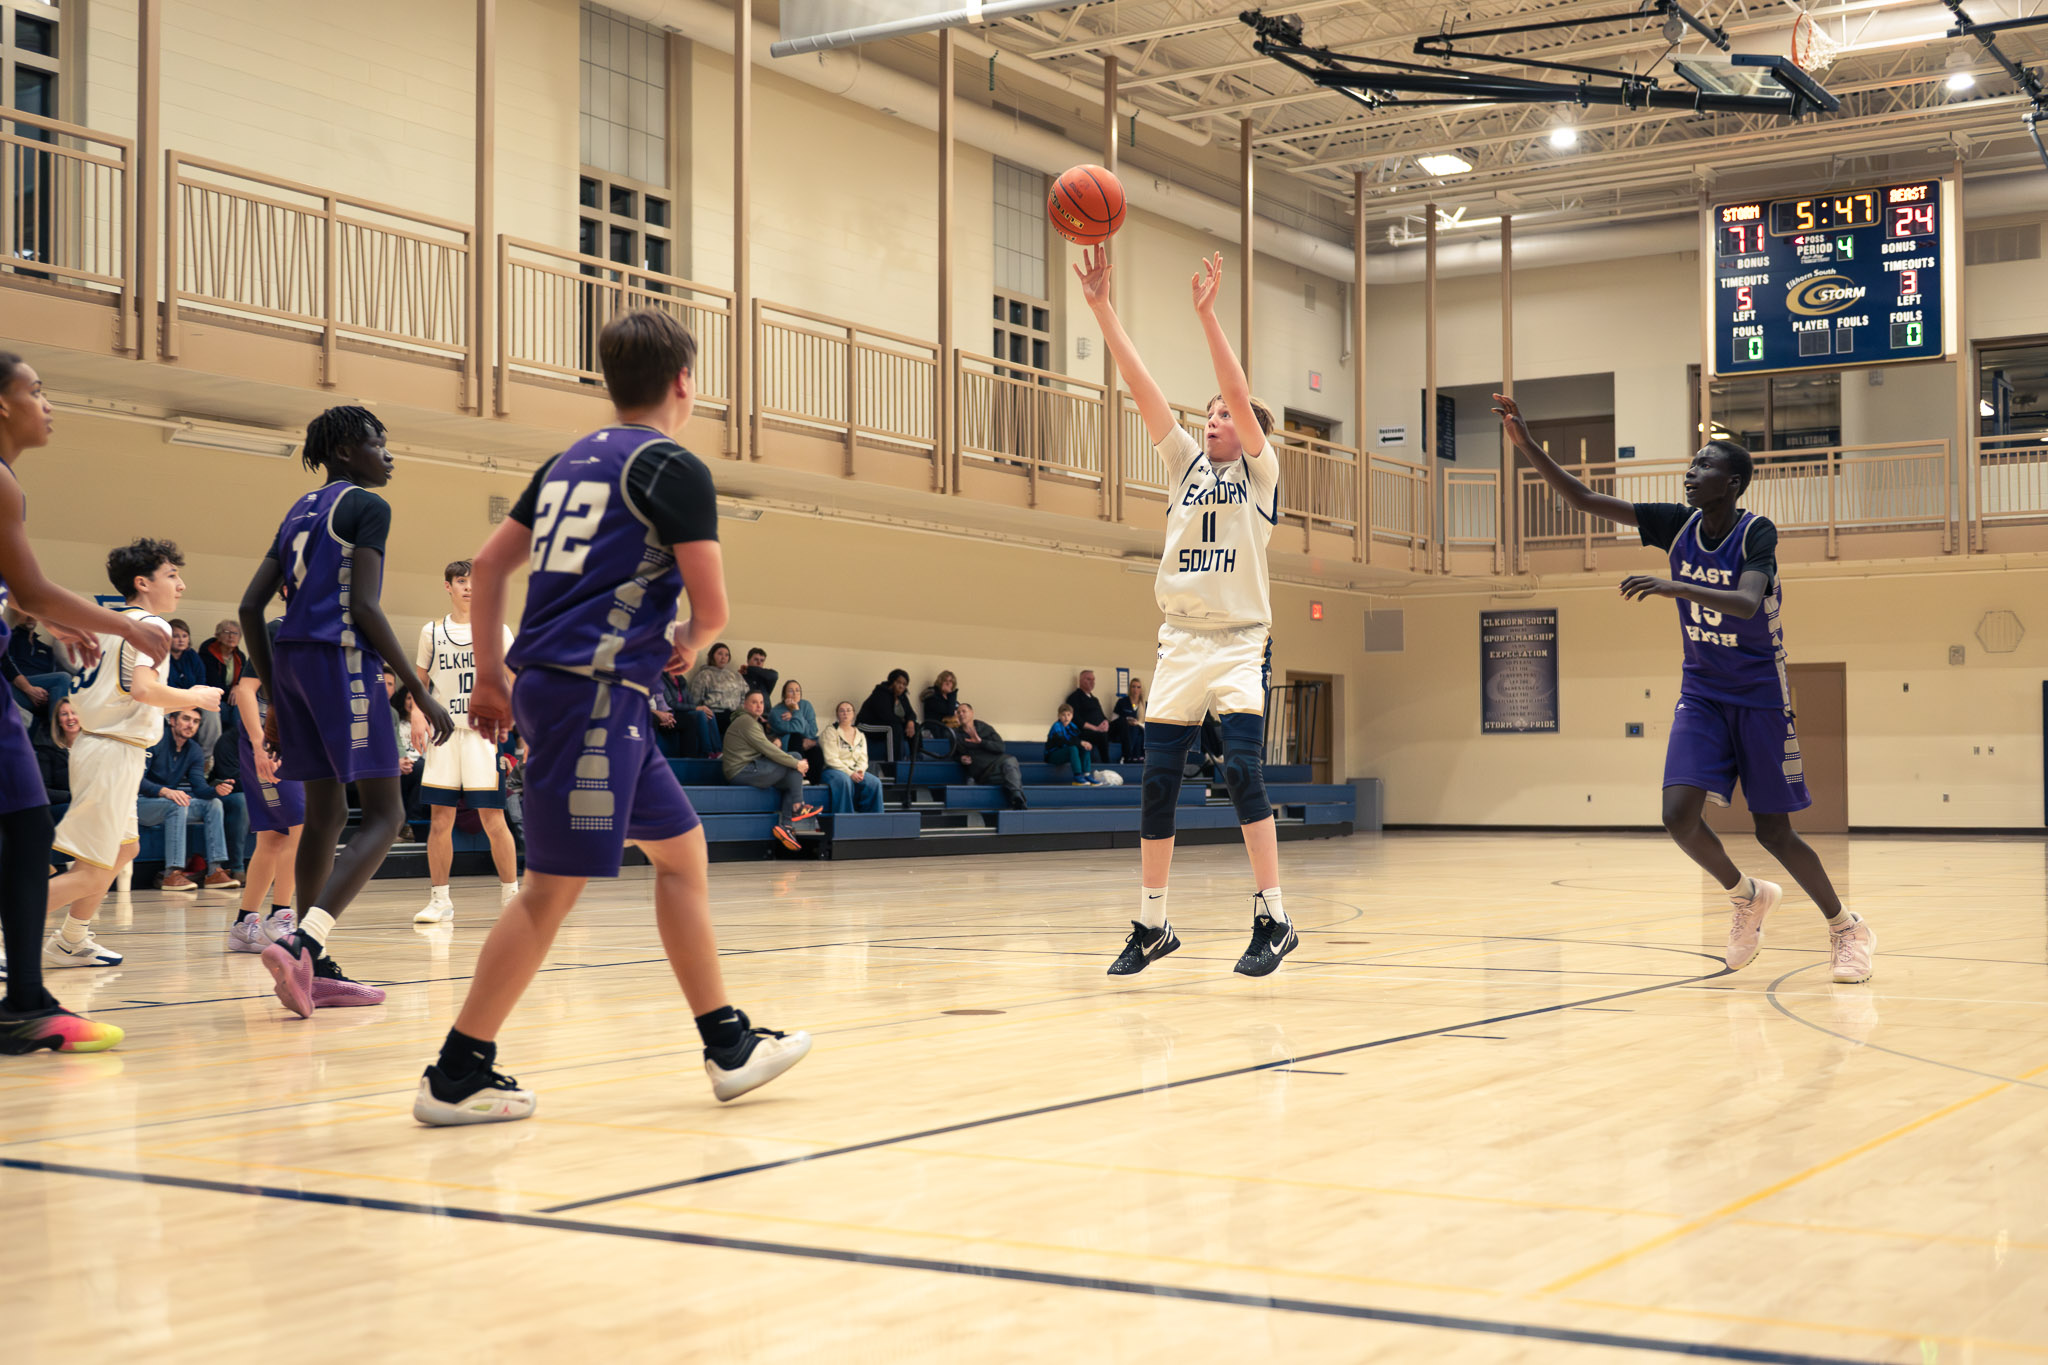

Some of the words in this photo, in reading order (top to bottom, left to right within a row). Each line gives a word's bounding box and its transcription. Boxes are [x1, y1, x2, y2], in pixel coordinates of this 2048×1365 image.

[1722, 204, 1760, 222] STORM
[1796, 194, 1872, 230] 5:47
[1896, 205, 1933, 236] 24
[1728, 224, 1763, 253] 71
[1805, 234, 1825, 244] POSS
[1838, 236, 1853, 258] 4
[1881, 240, 1916, 254] BONUS
[1796, 243, 1833, 256] PERIOD
[1737, 256, 1770, 270] BONUS
[1883, 256, 1935, 272] TIMEOUTS
[1720, 273, 1769, 288] TIMEOUTS
[1813, 268, 1837, 277] South
[1901, 270, 1917, 294] 3
[1737, 286, 1752, 310] 5
[1820, 286, 1866, 301] STORM
[1897, 294, 1922, 307] LEFT
[1733, 310, 1756, 323] LEFT
[1792, 318, 1829, 332] PLAYER
[1836, 315, 1869, 328] FOULS
[1890, 310, 1923, 323] FOULS
[1733, 325, 1763, 338] FOULS
[1906, 322, 1922, 346] 0
[1748, 337, 1763, 360] 0
[530, 480, 611, 575] 22
[1202, 511, 1216, 542] 11
[292, 531, 310, 590] 1
[1179, 549, 1236, 572] SOUTH
[1680, 560, 1732, 585] EAST
[1483, 617, 1523, 627] ELKHORN
[1526, 616, 1555, 625] SOUTH
[1483, 633, 1555, 643] SPORTSMANSHIP
[1685, 625, 1738, 647] HIGH
[1489, 649, 1548, 659] EXPECTATION
[458, 672, 473, 694] 10
[1484, 721, 1513, 729] STORM
[1530, 720, 1555, 728] PRIDE
